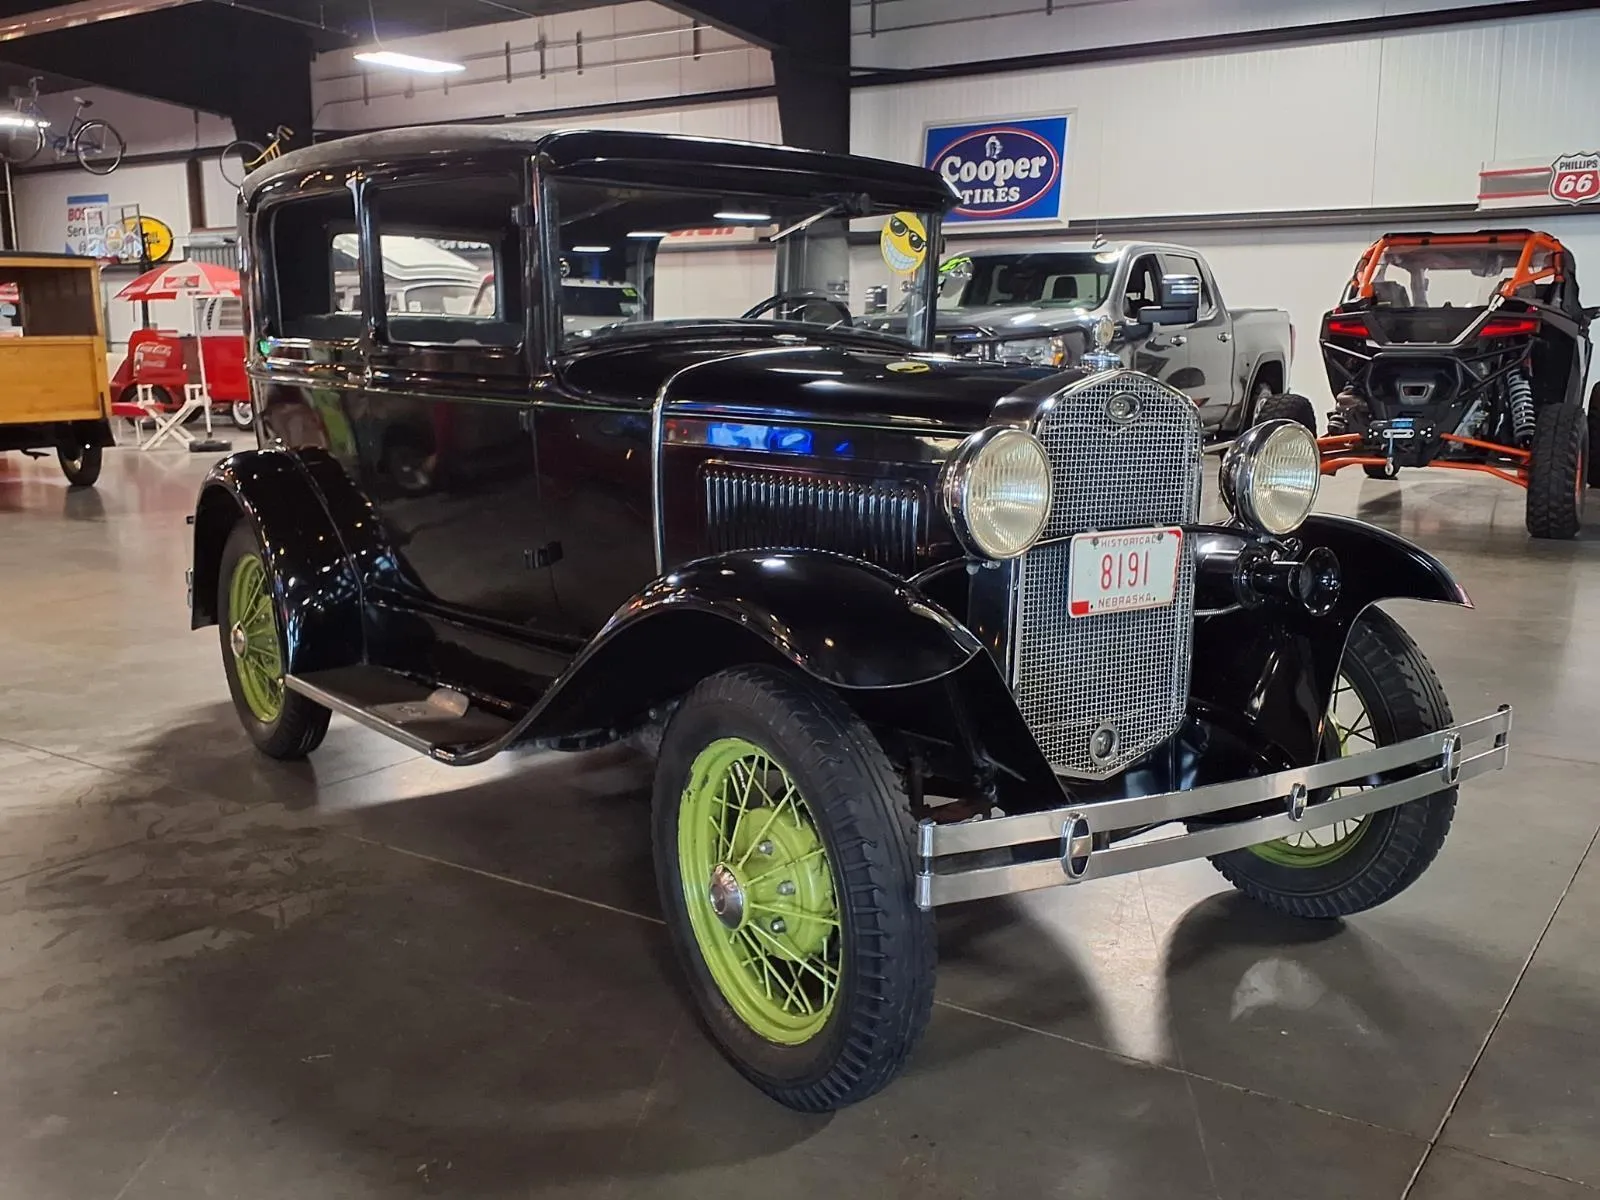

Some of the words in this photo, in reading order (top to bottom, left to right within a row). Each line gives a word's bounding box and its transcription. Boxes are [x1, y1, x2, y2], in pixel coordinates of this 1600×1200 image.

[940, 156, 1047, 187] Cooper
[1559, 159, 1598, 170] PHILLIPS
[1558, 173, 1594, 194] 66
[961, 186, 1020, 205] TIRES
[1101, 535, 1158, 548] HISTORICAL
[1101, 551, 1149, 590] 8191
[1098, 592, 1152, 609] NEBRASKA
